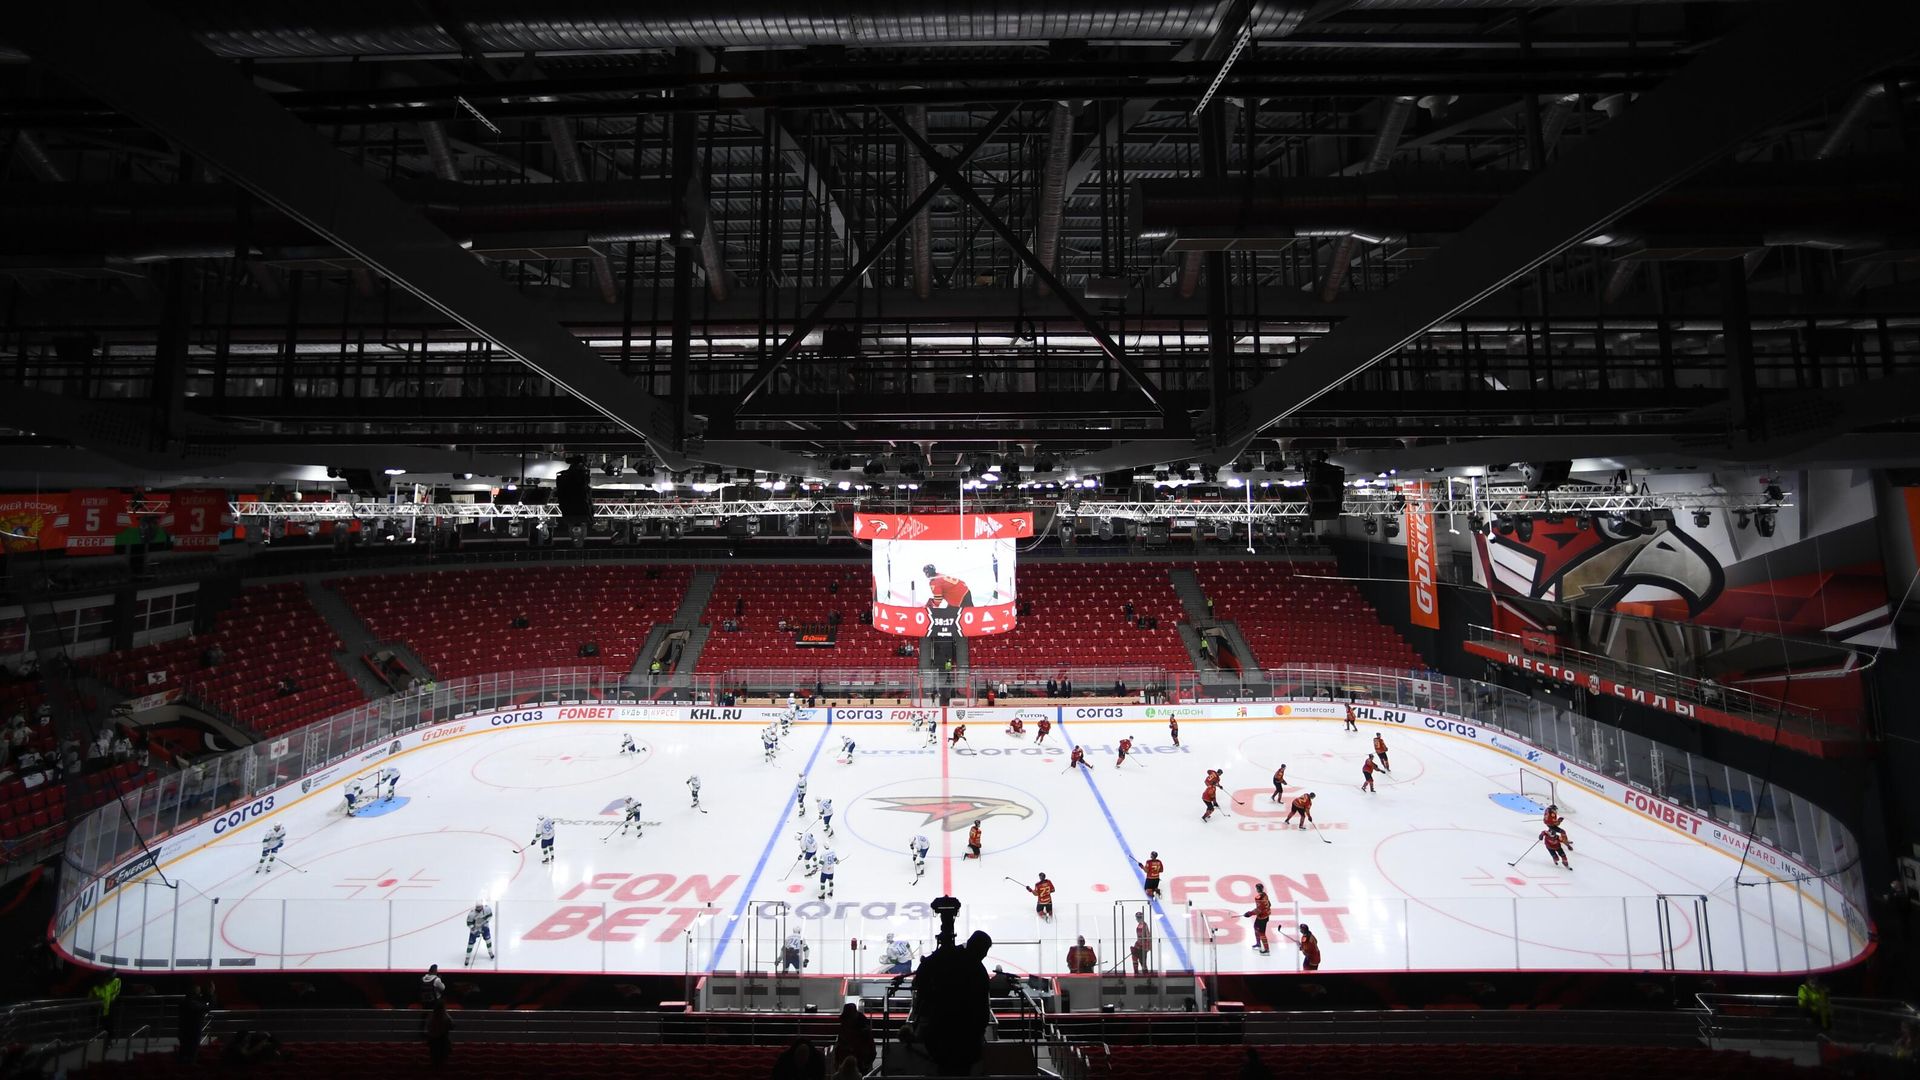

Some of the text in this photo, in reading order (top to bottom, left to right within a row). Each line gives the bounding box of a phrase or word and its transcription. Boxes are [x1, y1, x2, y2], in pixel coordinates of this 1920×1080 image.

[86, 508, 100, 531] 5
[190, 508, 205, 532] 3
[77, 537, 105, 546] СССР
[916, 612, 925, 624] 0
[965, 612, 974, 624] 0
[1507, 653, 1696, 718] МЕСТО СИЛЫ
[491, 711, 543, 726] согаз
[558, 708, 616, 720] FONBET
[689, 709, 742, 720] KHL.RU
[836, 709, 883, 720] согаз
[1076, 708, 1123, 718] согаз
[1294, 706, 1335, 714] mastercard
[1425, 717, 1477, 739] согаз
[956, 746, 1065, 756] согаз
[213, 796, 275, 834] согаз
[1624, 791, 1702, 835] FONBET
[558, 873, 741, 902] FON
[1168, 873, 1331, 905] FON
[758, 901, 932, 920] согаз
[521, 905, 731, 943] BET
[1191, 906, 1350, 945] BET
